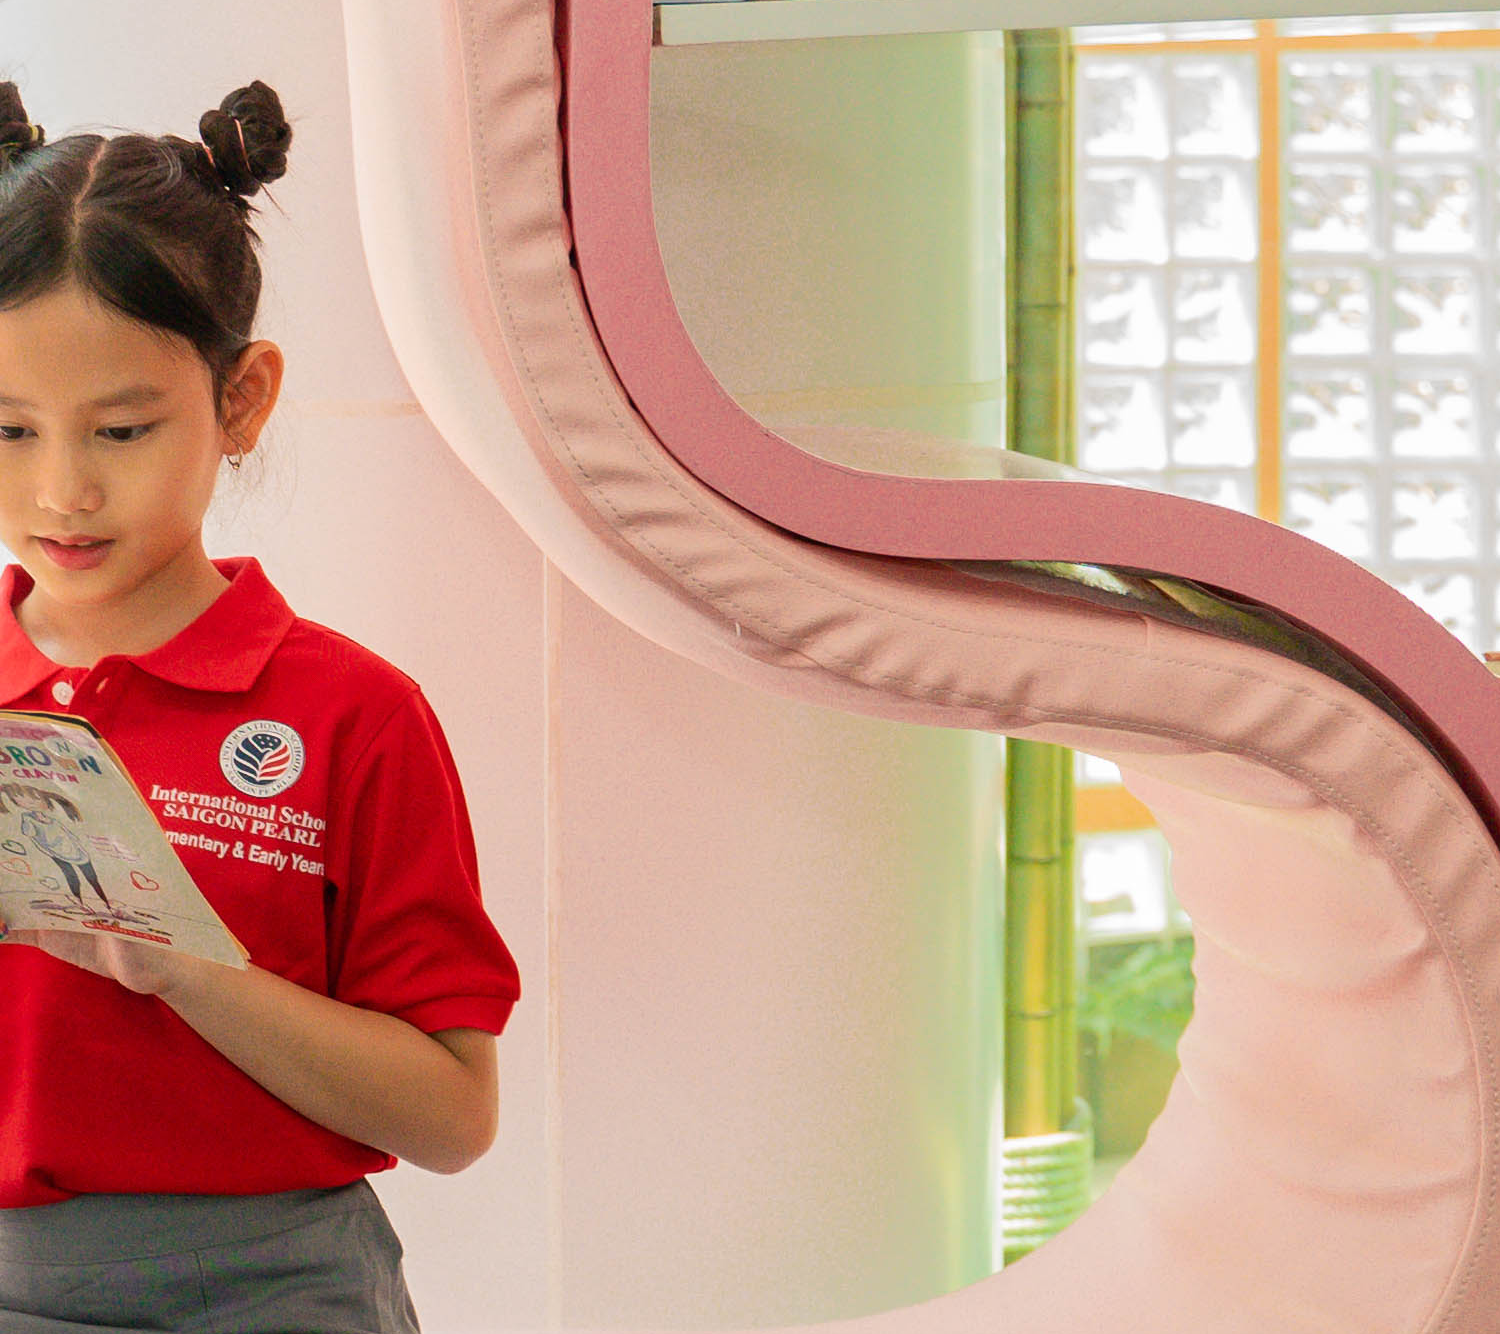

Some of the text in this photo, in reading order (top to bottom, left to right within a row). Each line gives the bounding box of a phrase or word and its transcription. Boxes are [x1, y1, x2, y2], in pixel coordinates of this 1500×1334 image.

[13, 768, 79, 784] CRAYON
[150, 784, 275, 820] International
[163, 803, 320, 848] SAIGON PEARL
[233, 842, 244, 859] &
[249, 845, 288, 872] Early
